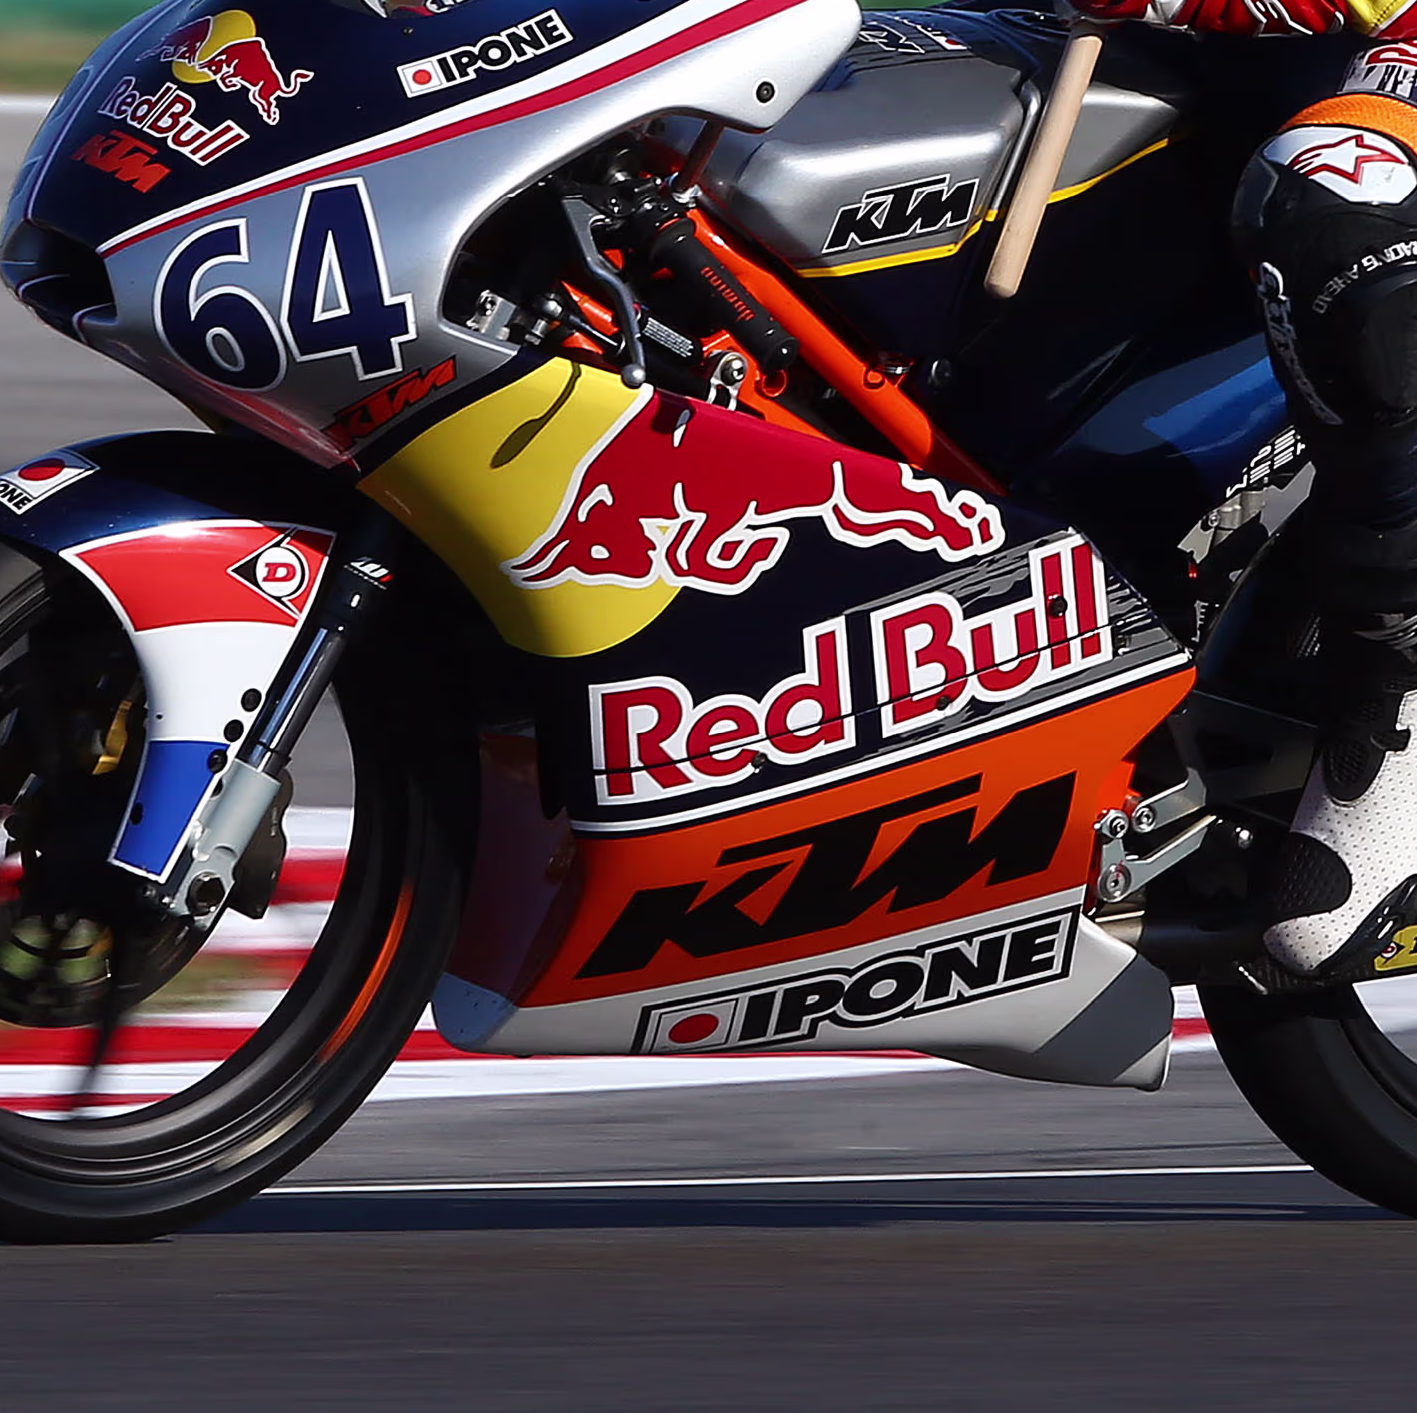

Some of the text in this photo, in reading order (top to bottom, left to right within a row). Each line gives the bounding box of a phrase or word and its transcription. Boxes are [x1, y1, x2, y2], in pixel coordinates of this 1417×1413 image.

[437, 15, 566, 83] IPONE
[71, 129, 171, 193] KTM
[97, 76, 249, 166] Red Bull
[822, 173, 980, 254] KTM
[154, 177, 416, 390] 64
[328, 355, 458, 447] KTM
[594, 538, 1108, 800] Red Bull
[573, 772, 1078, 980] KTM
[738, 919, 1064, 1042] IPONE
